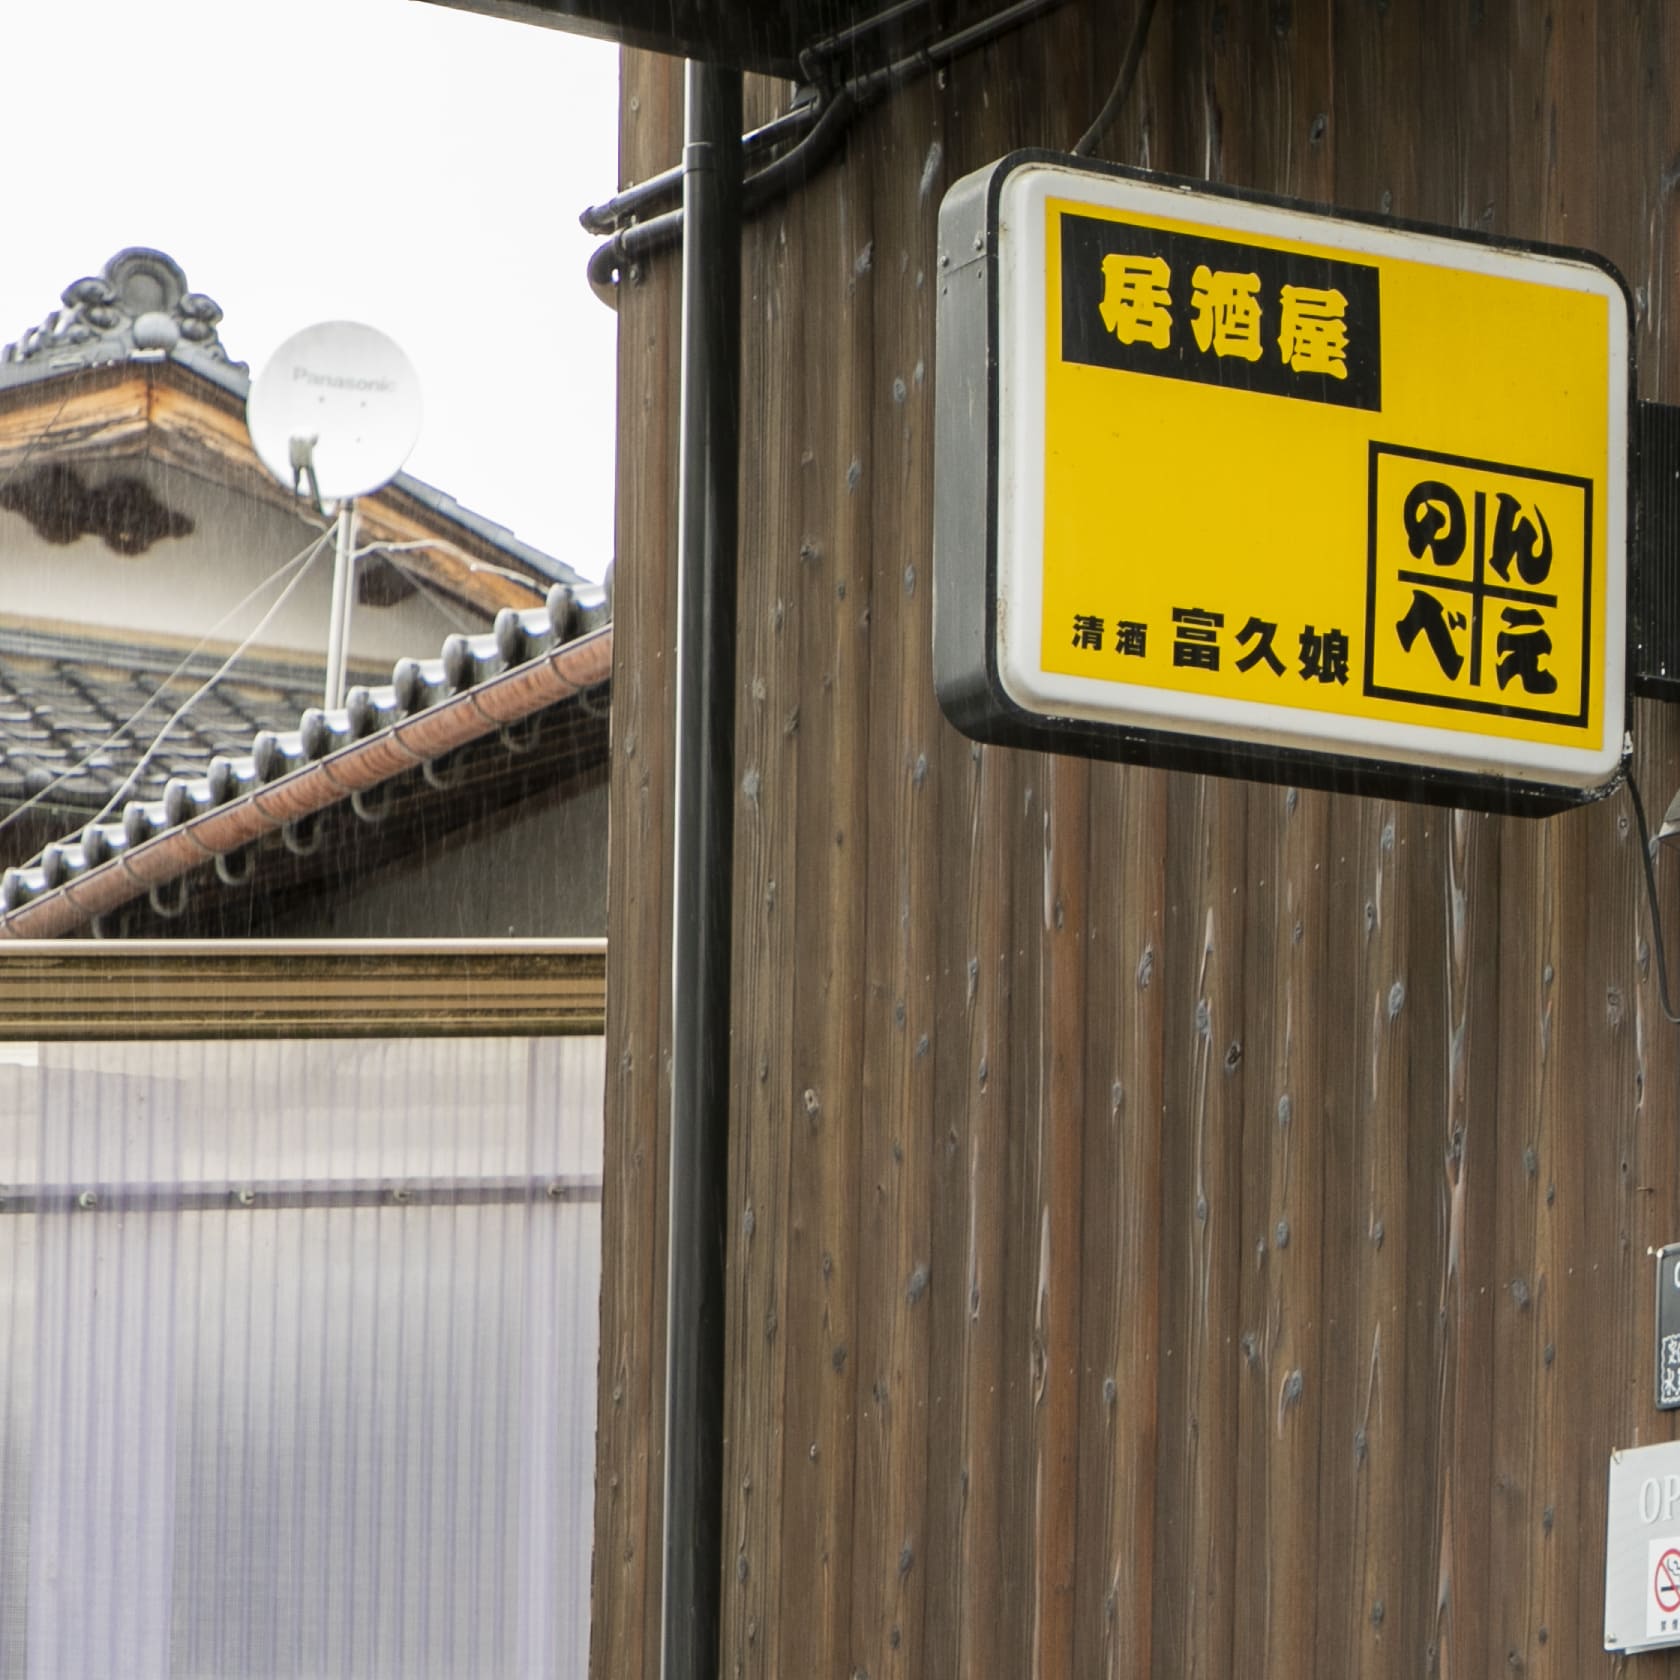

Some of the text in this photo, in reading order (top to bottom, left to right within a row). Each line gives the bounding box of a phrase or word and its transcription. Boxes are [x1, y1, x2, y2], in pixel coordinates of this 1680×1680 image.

[1098, 252, 1350, 380] 居酒屋
[293, 366, 396, 392] Panasonic
[1402, 480, 1554, 583] のん
[1071, 607, 1350, 688] 清酒 富久娘
[1395, 588, 1558, 695] べえ
